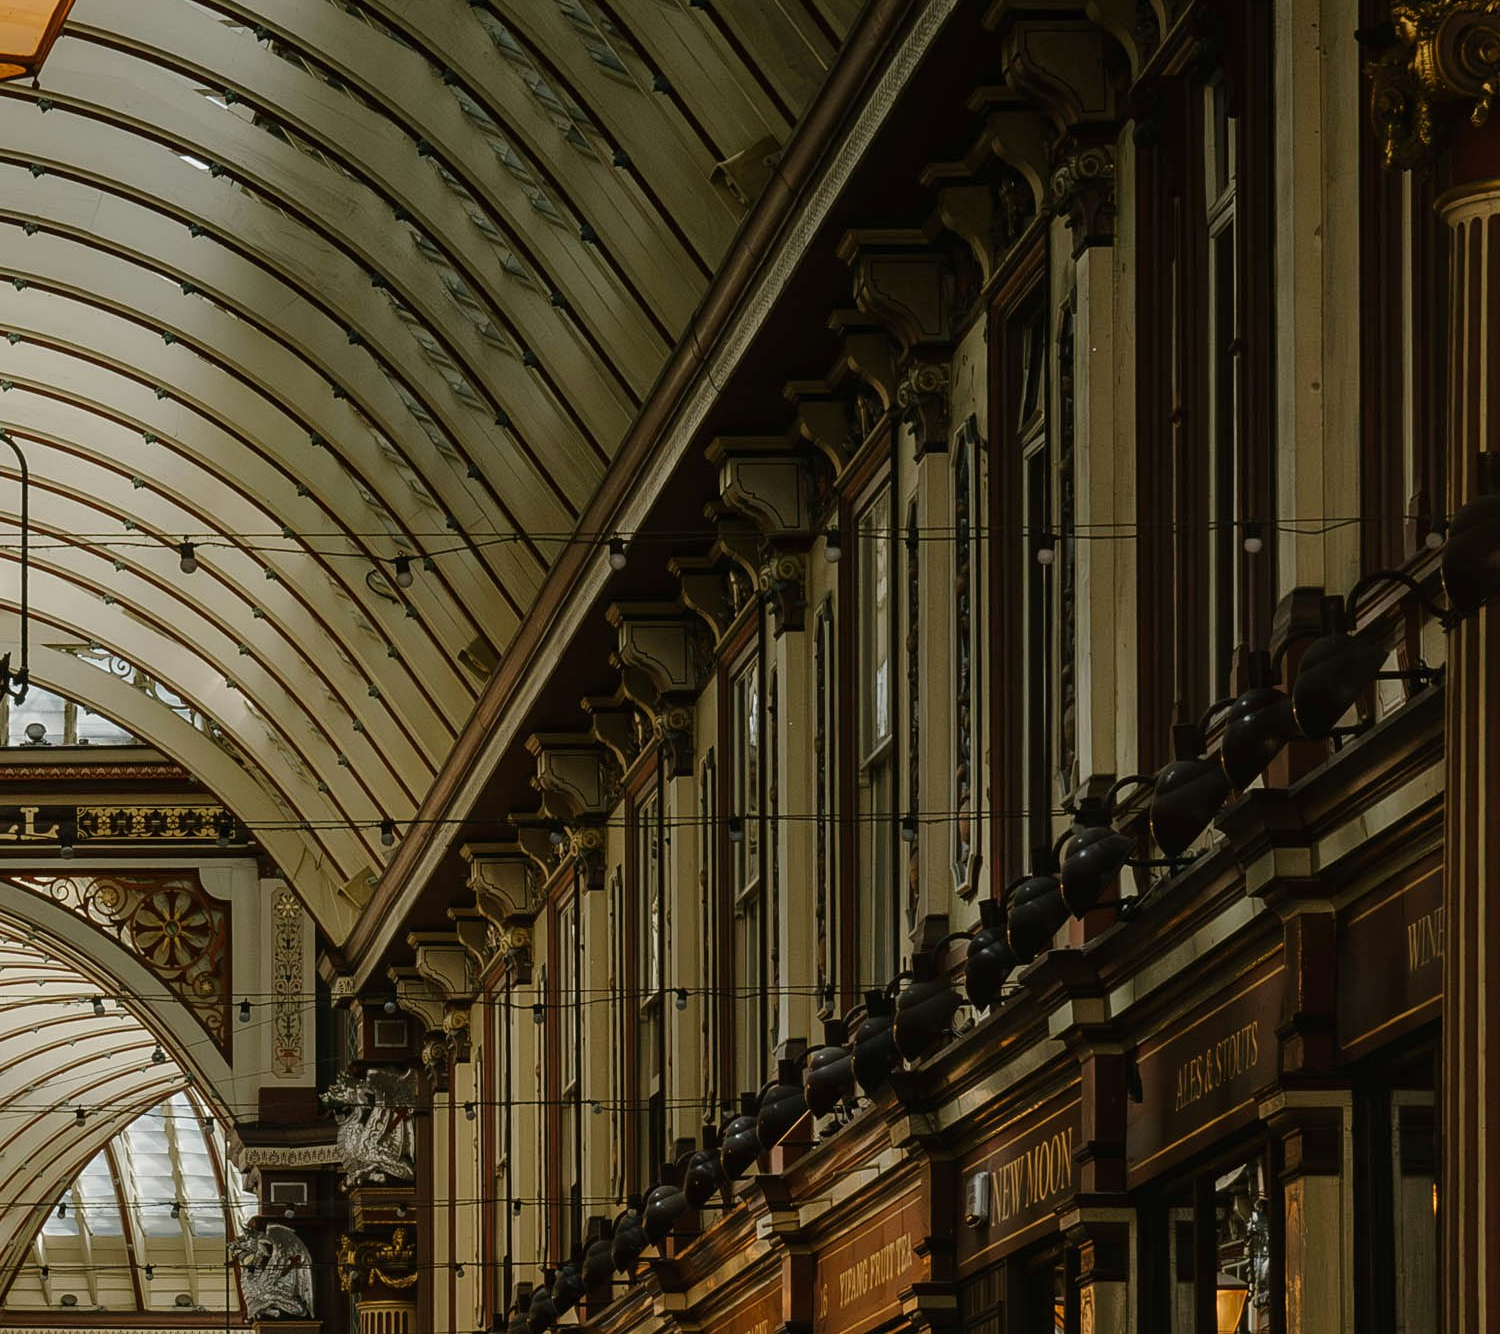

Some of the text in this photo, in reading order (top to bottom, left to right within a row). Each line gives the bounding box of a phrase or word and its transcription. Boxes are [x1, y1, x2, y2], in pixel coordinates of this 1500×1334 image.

[1176, 1020, 1258, 1112] ALES & STOUTS
[991, 1127, 1073, 1227] NEW MOON
[839, 1232, 912, 1308] YIFANG FRUIT TEA
